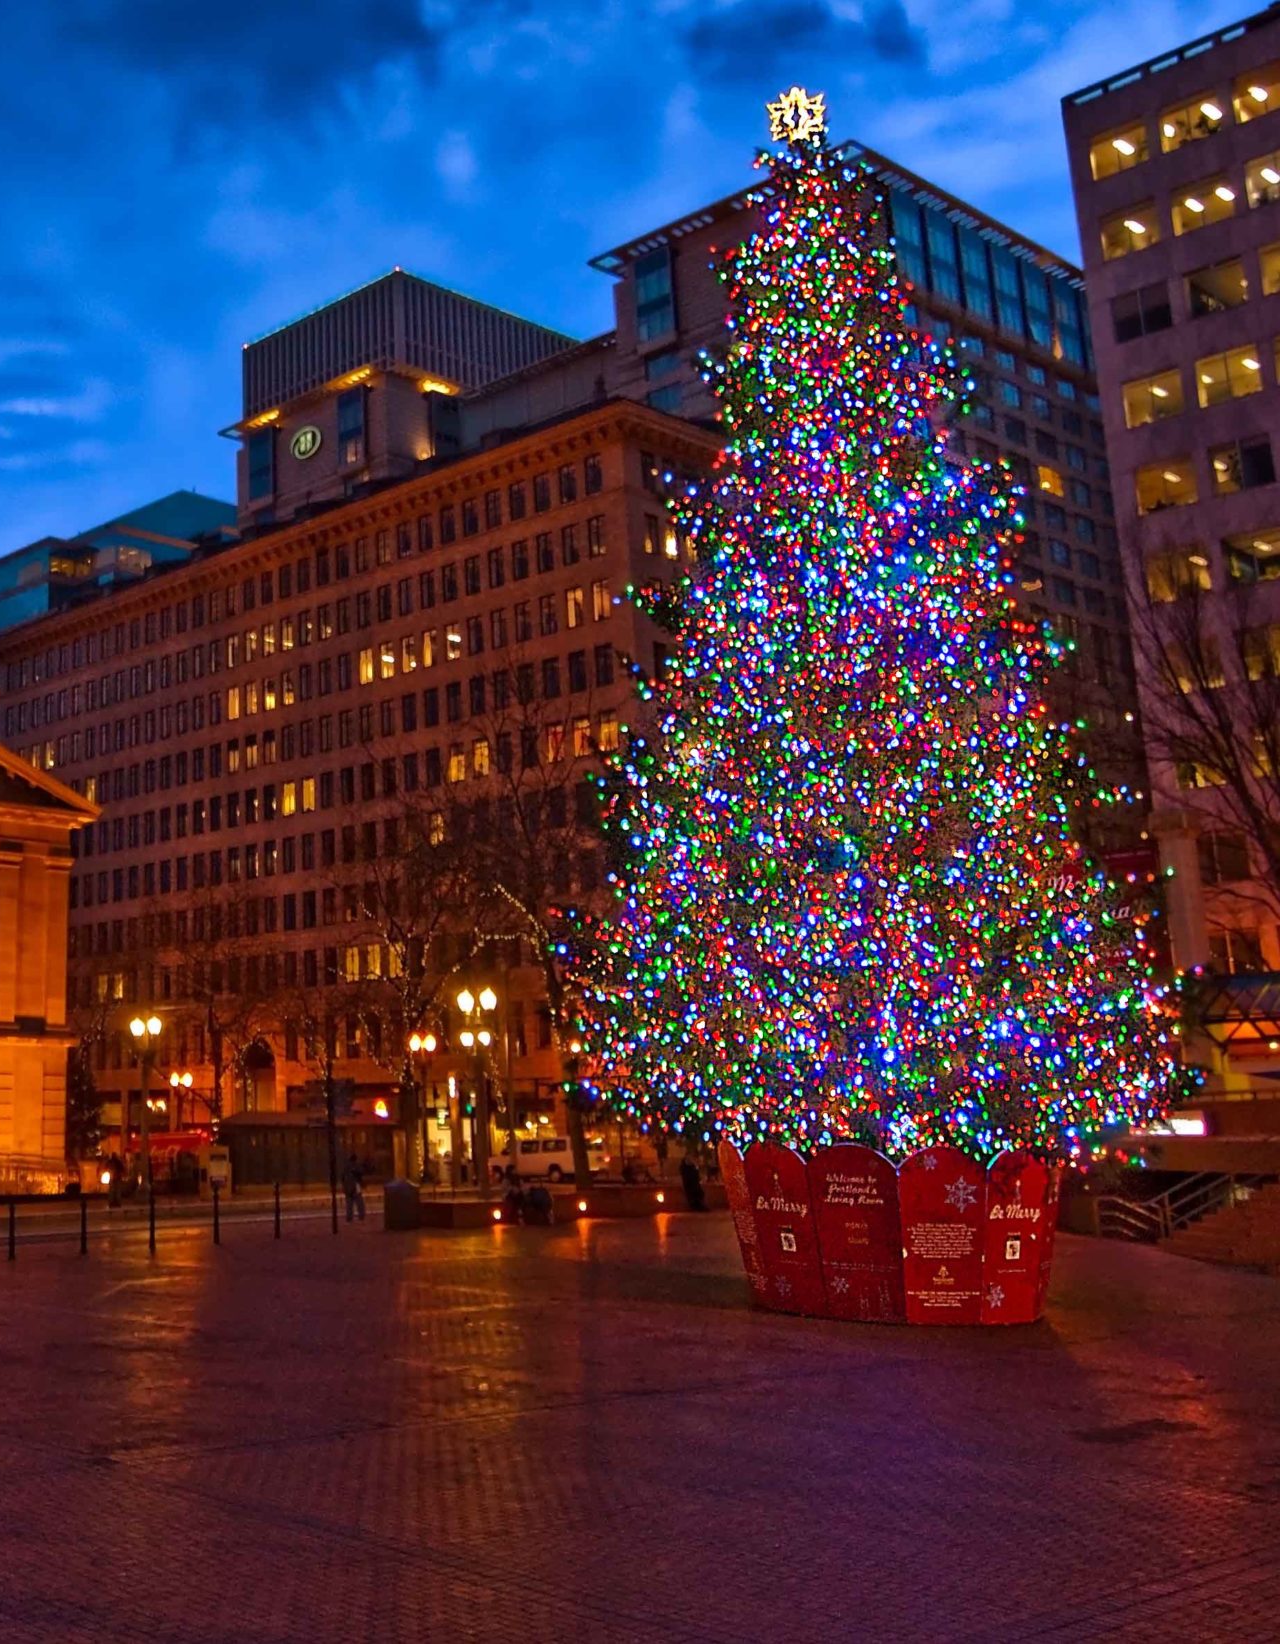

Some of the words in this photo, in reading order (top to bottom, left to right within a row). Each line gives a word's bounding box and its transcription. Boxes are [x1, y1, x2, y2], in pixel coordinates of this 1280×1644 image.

[756, 1195, 769, 1211] Be
[770, 1196, 808, 1218] Merry
[989, 1203, 1004, 1219] Be
[1005, 1202, 1040, 1222] Merry
